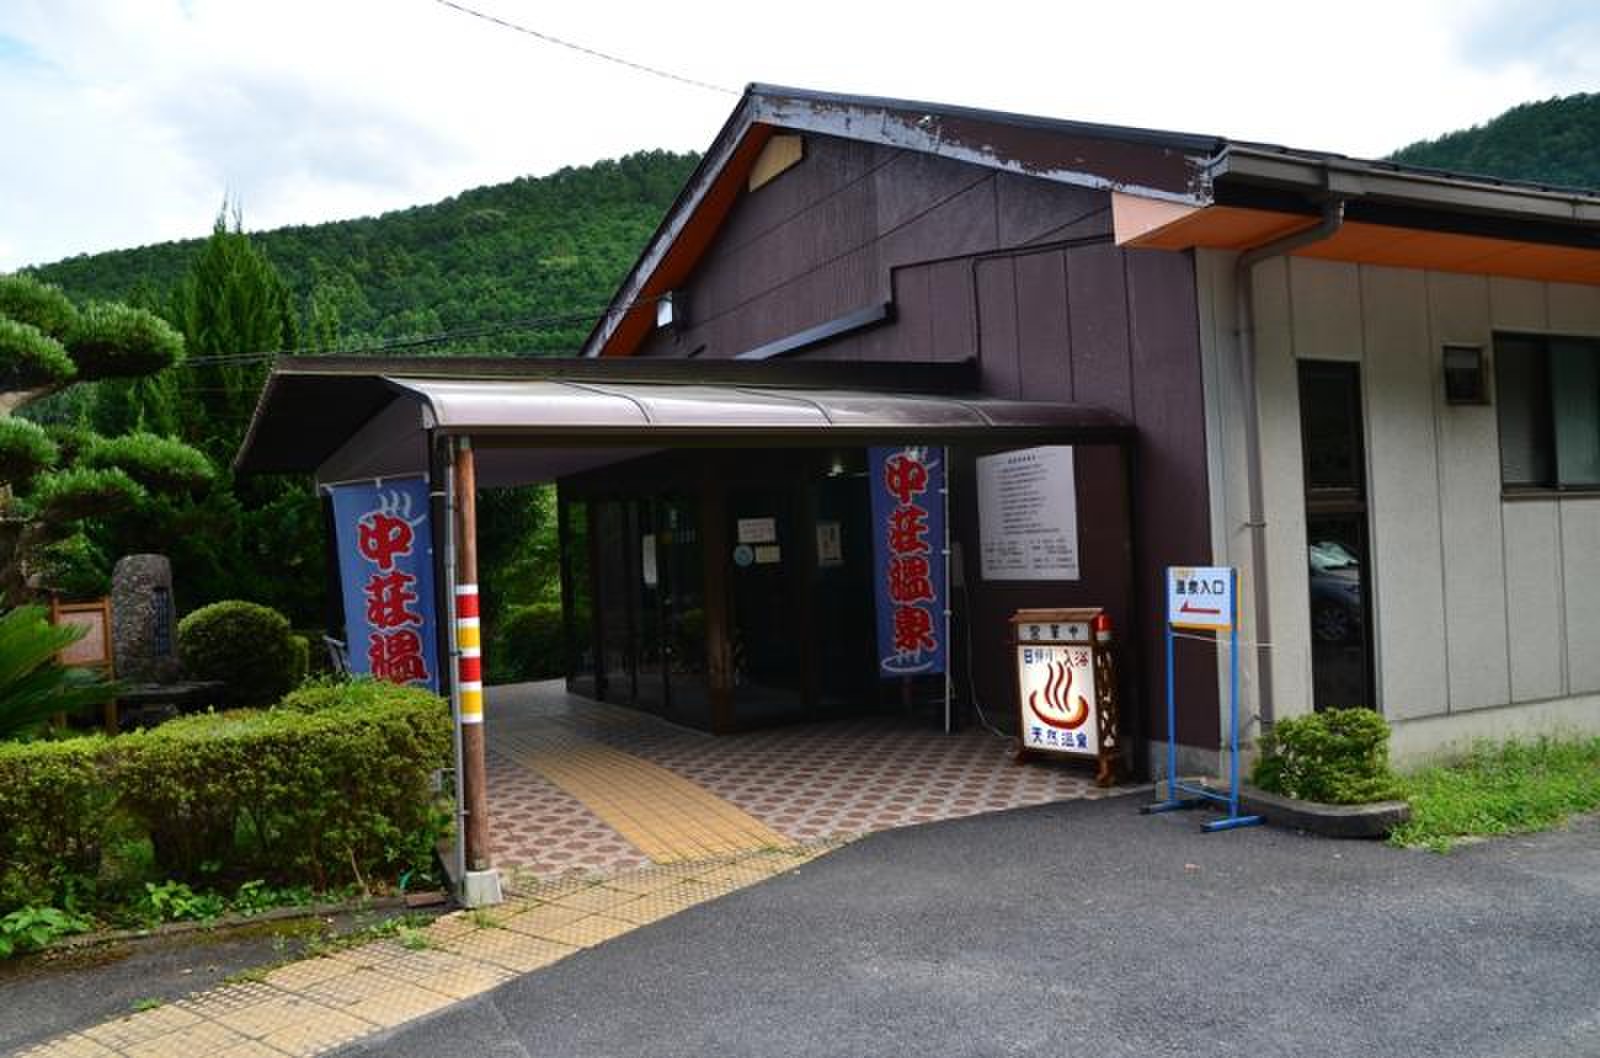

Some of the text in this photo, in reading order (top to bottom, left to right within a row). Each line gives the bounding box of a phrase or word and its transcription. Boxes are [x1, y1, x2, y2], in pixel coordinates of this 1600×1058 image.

[884, 453, 936, 655] 中荘温泉
[1031, 726, 1088, 749] 天然温泉
